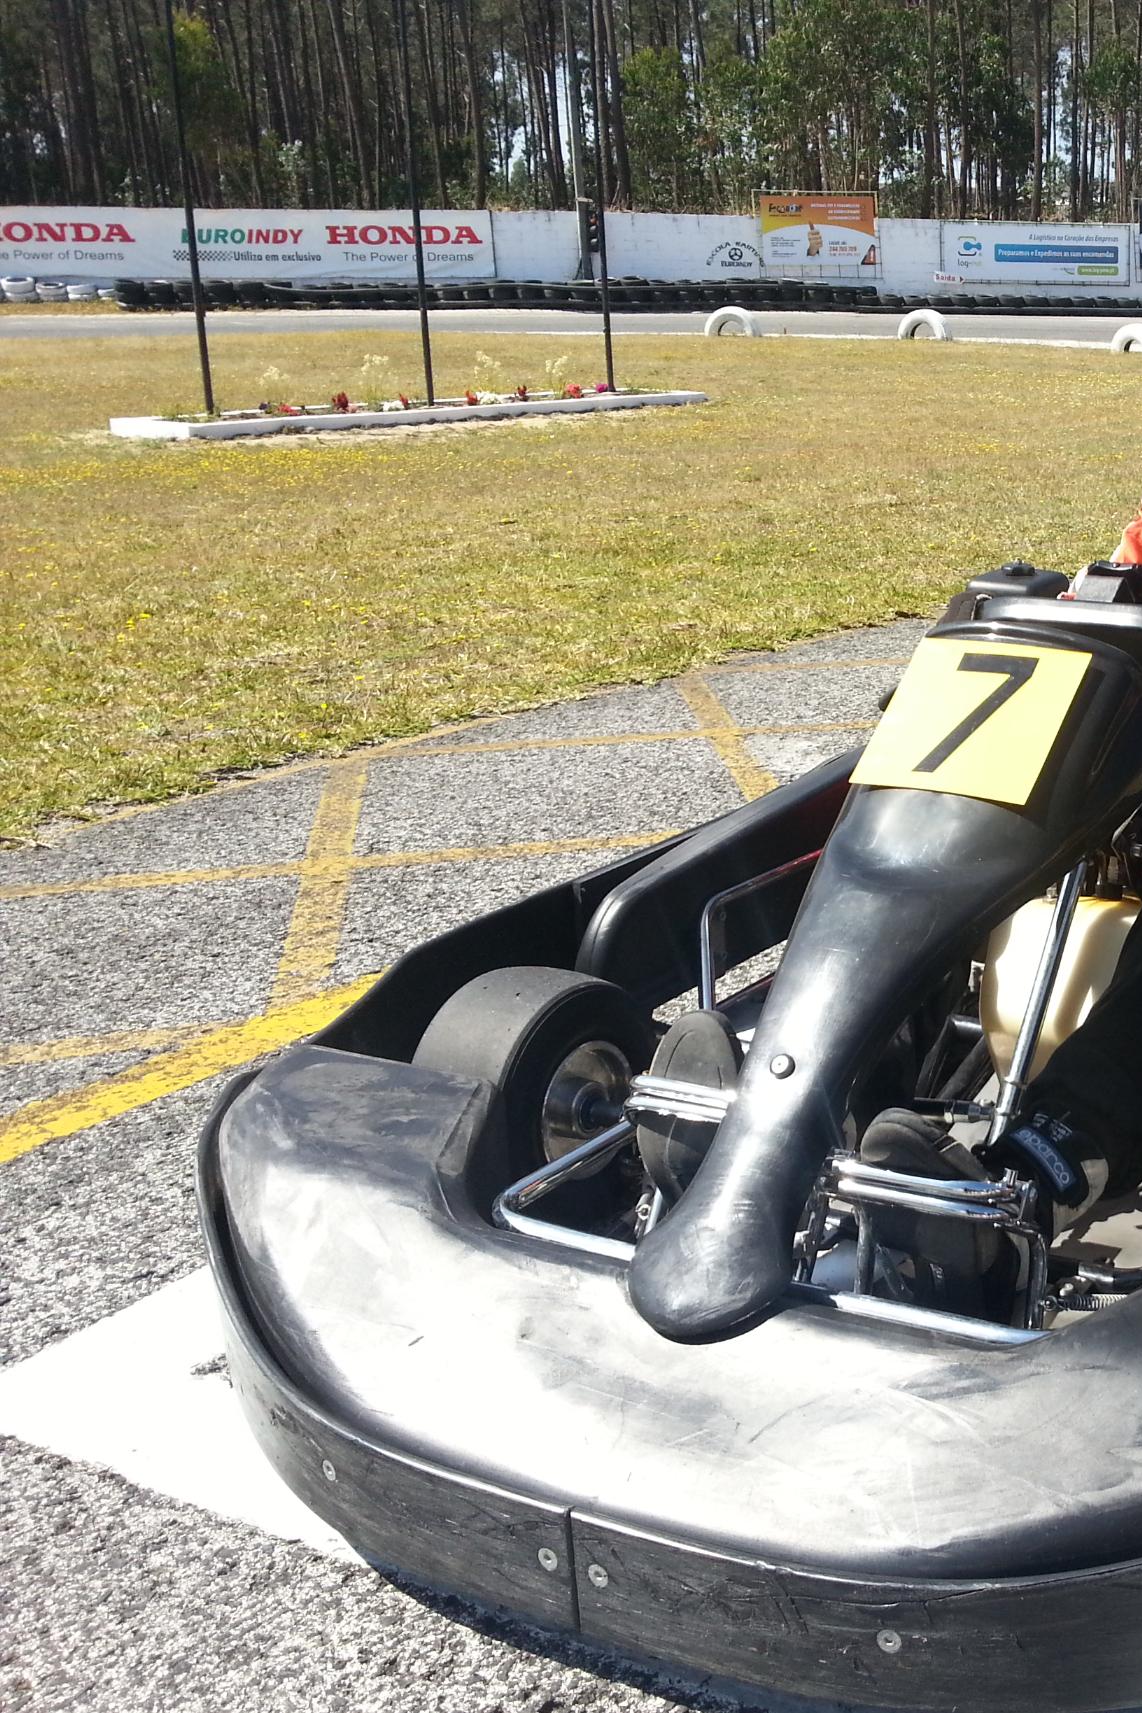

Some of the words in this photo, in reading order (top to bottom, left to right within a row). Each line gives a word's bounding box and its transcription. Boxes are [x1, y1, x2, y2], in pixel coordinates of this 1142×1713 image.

[0, 221, 136, 243] ONDA
[325, 224, 483, 246] HONDA
[13, 249, 54, 260] Power
[61, 249, 71, 260] of
[74, 249, 125, 261] Dreams
[265, 254, 279, 262] em
[281, 252, 322, 262] exclusivo
[343, 252, 367, 262] The
[370, 251, 408, 262] Power
[427, 251, 474, 262] Dreams
[912, 652, 1040, 773] 7
[1015, 1129, 1070, 1185] sparco
